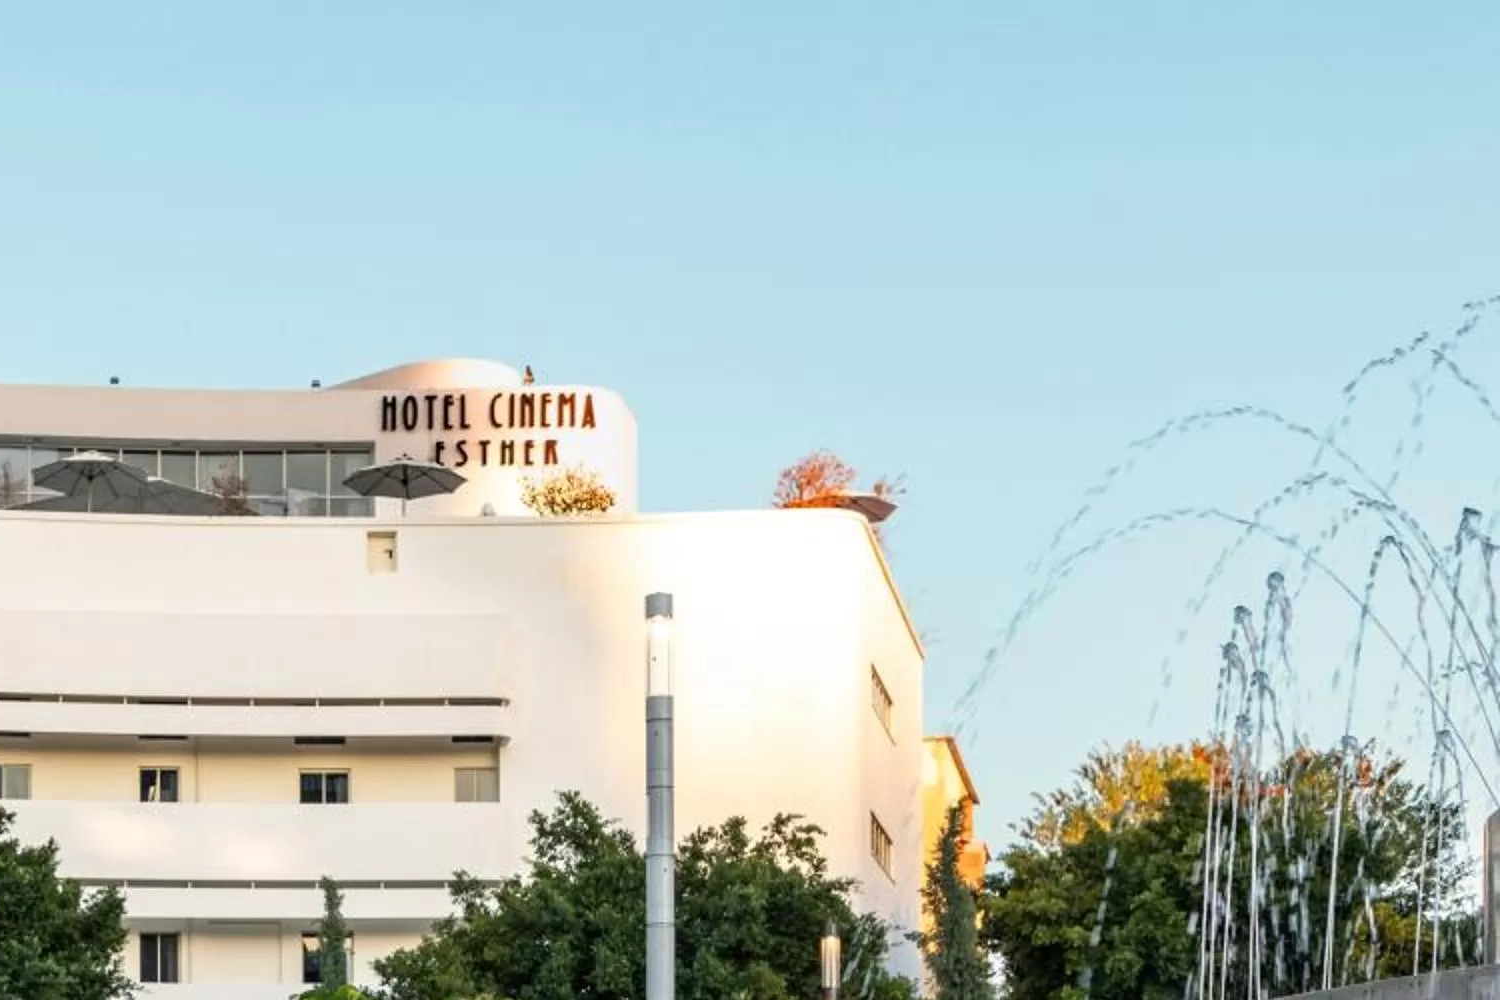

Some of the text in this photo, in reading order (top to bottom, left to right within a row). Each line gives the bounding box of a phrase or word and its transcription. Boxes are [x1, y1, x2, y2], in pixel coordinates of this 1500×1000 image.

[381, 391, 596, 432] HOTEL CINEMA
[435, 439, 559, 467] ESTHER
